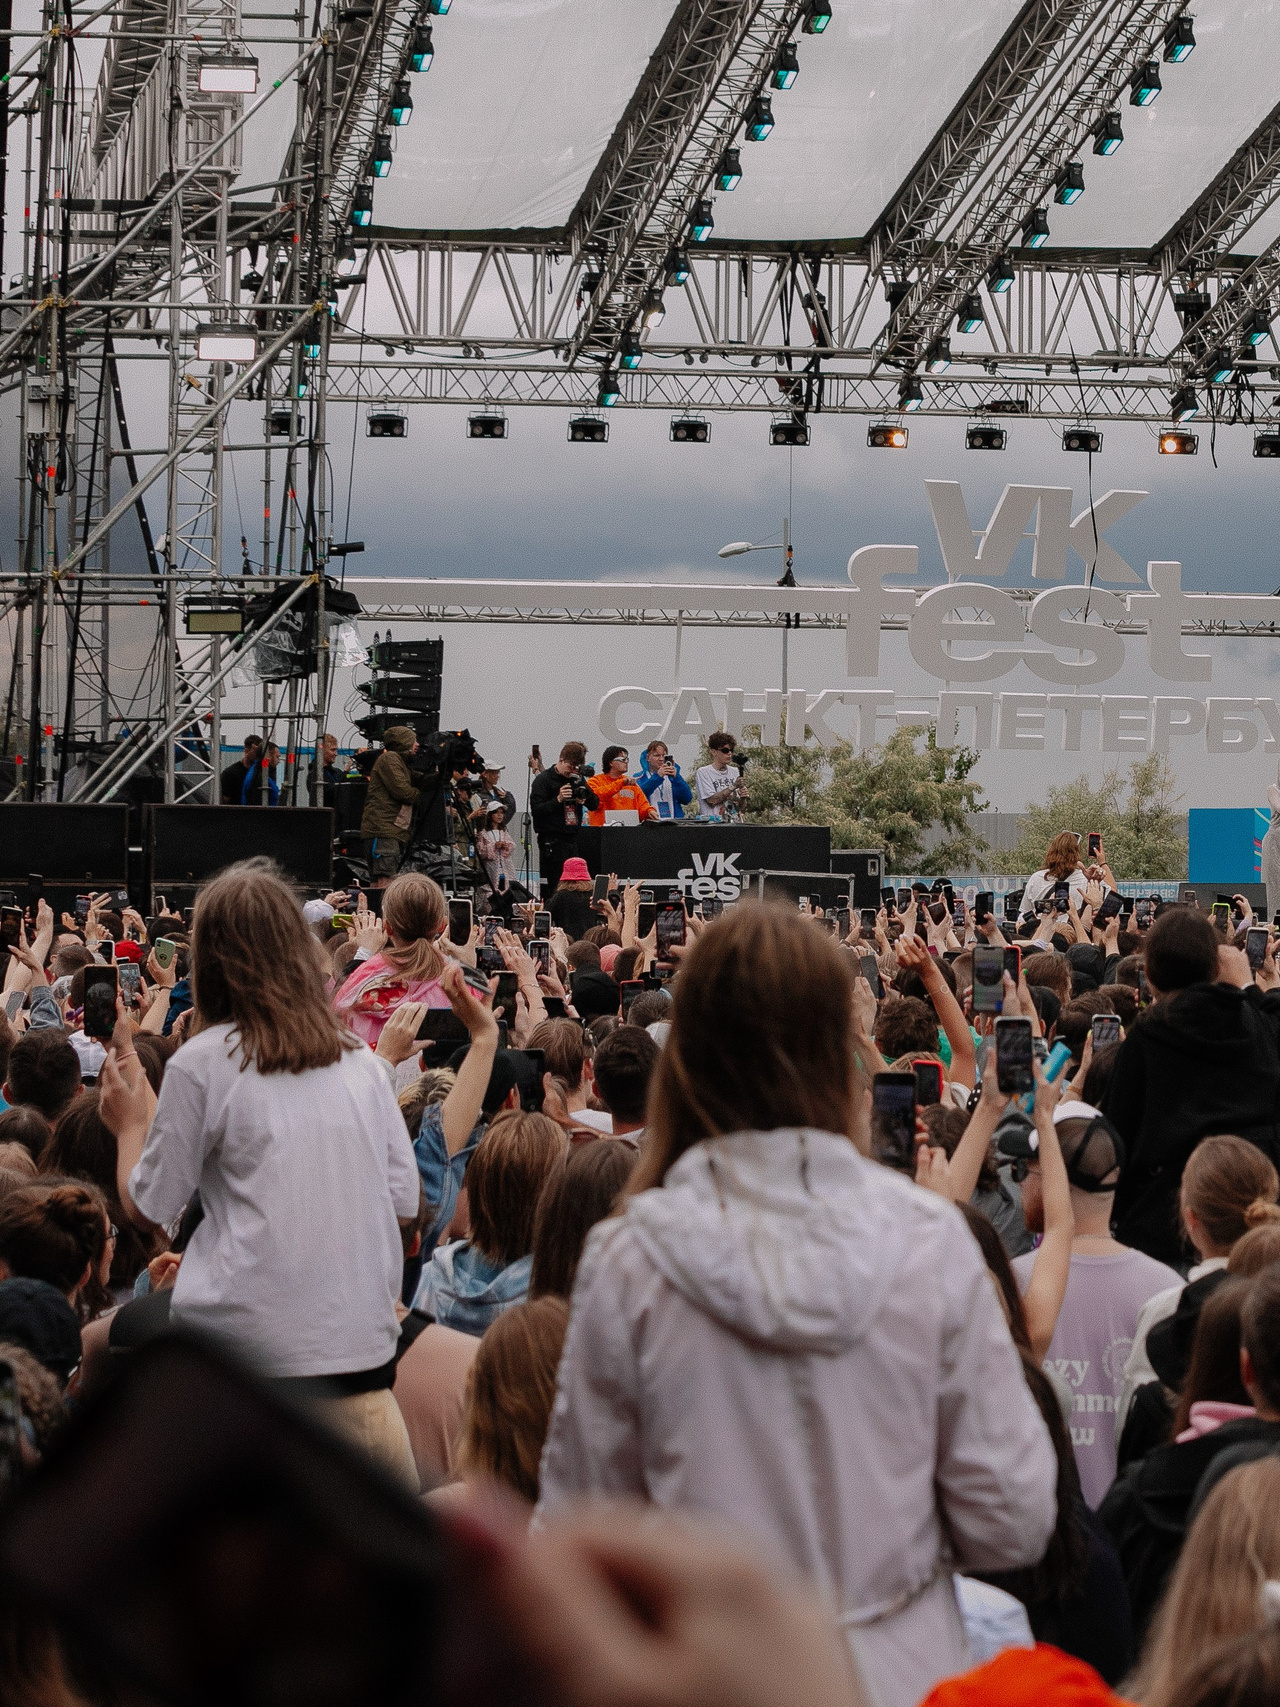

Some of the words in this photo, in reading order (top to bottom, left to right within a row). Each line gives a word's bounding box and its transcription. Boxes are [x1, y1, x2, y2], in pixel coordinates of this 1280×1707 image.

[924, 479, 1150, 583] VK
[846, 544, 1213, 686] fest
[677, 868, 741, 901] fes
[691, 853, 741, 876] VK
